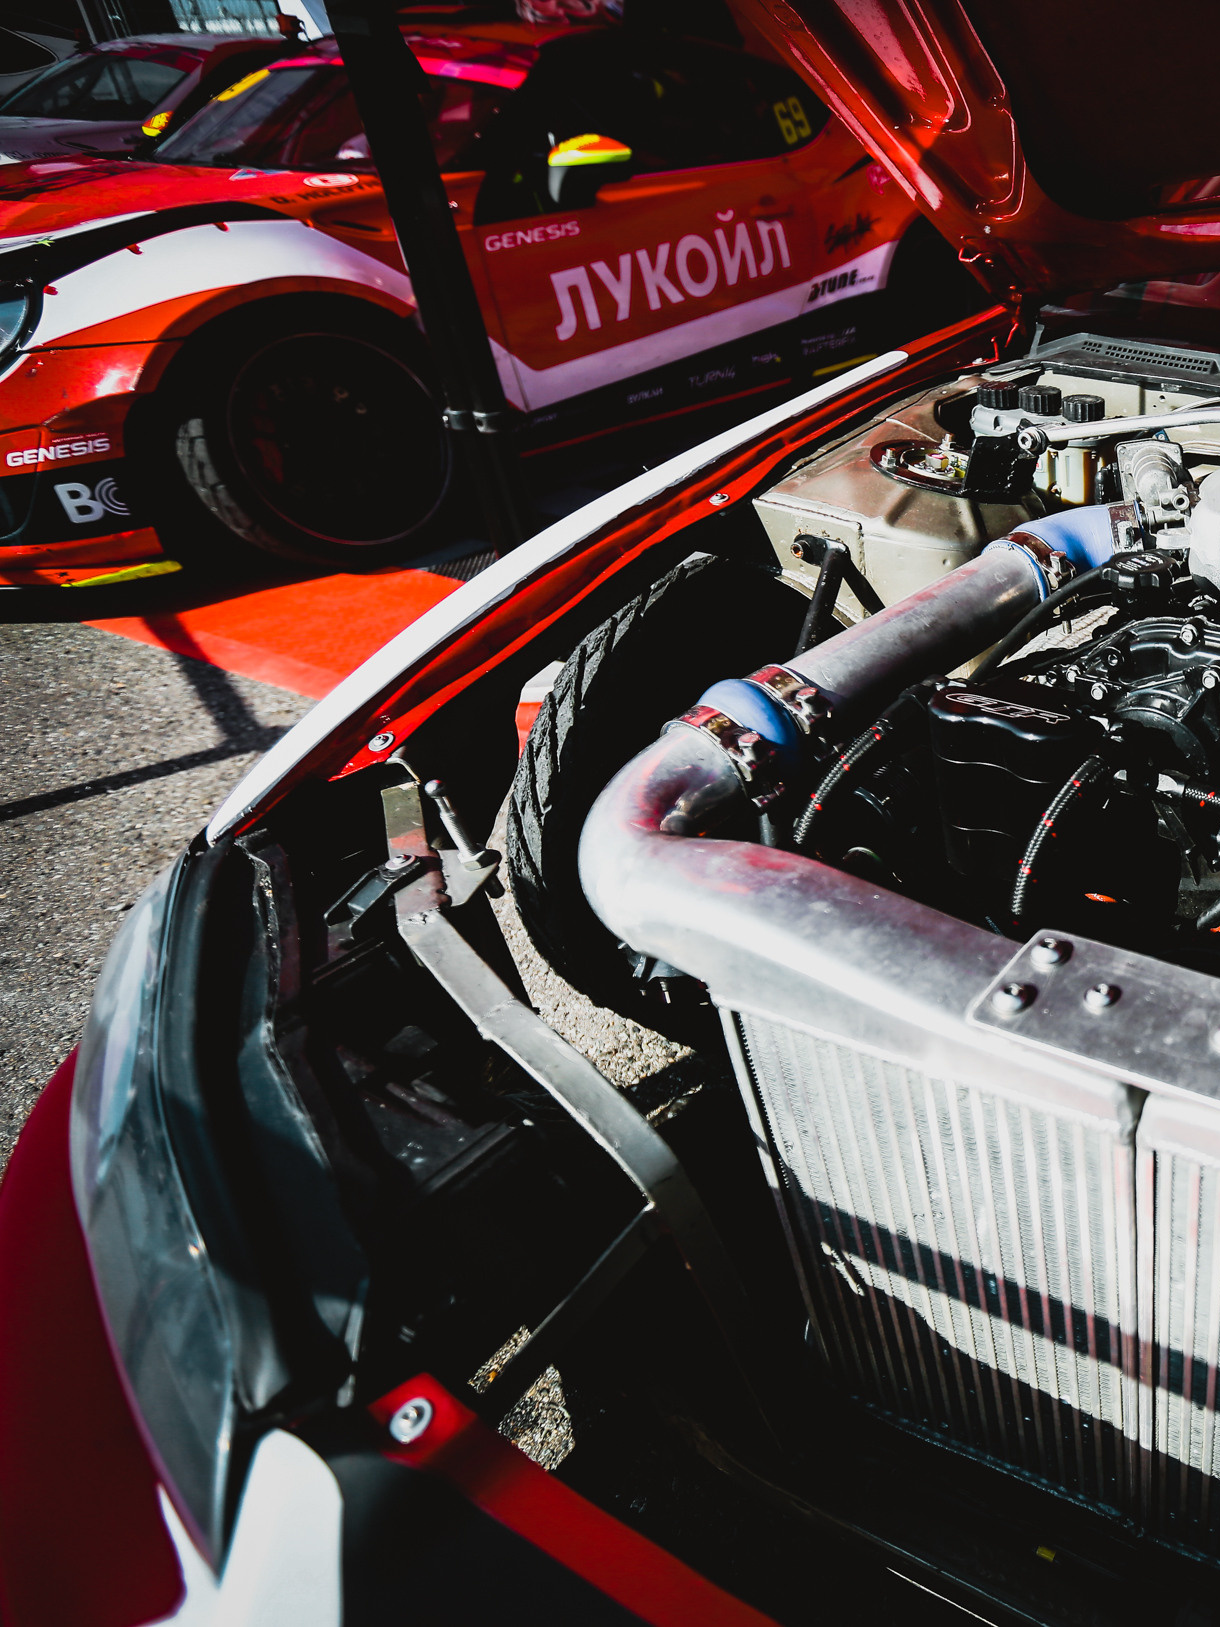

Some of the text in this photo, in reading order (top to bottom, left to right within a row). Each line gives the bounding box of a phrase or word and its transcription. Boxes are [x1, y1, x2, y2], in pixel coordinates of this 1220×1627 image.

[773, 96, 812, 145] 69
[484, 220, 581, 252] GENESIS
[549, 208, 792, 342] ЛУКОЙЛ
[6, 438, 111, 467] GENESIS
